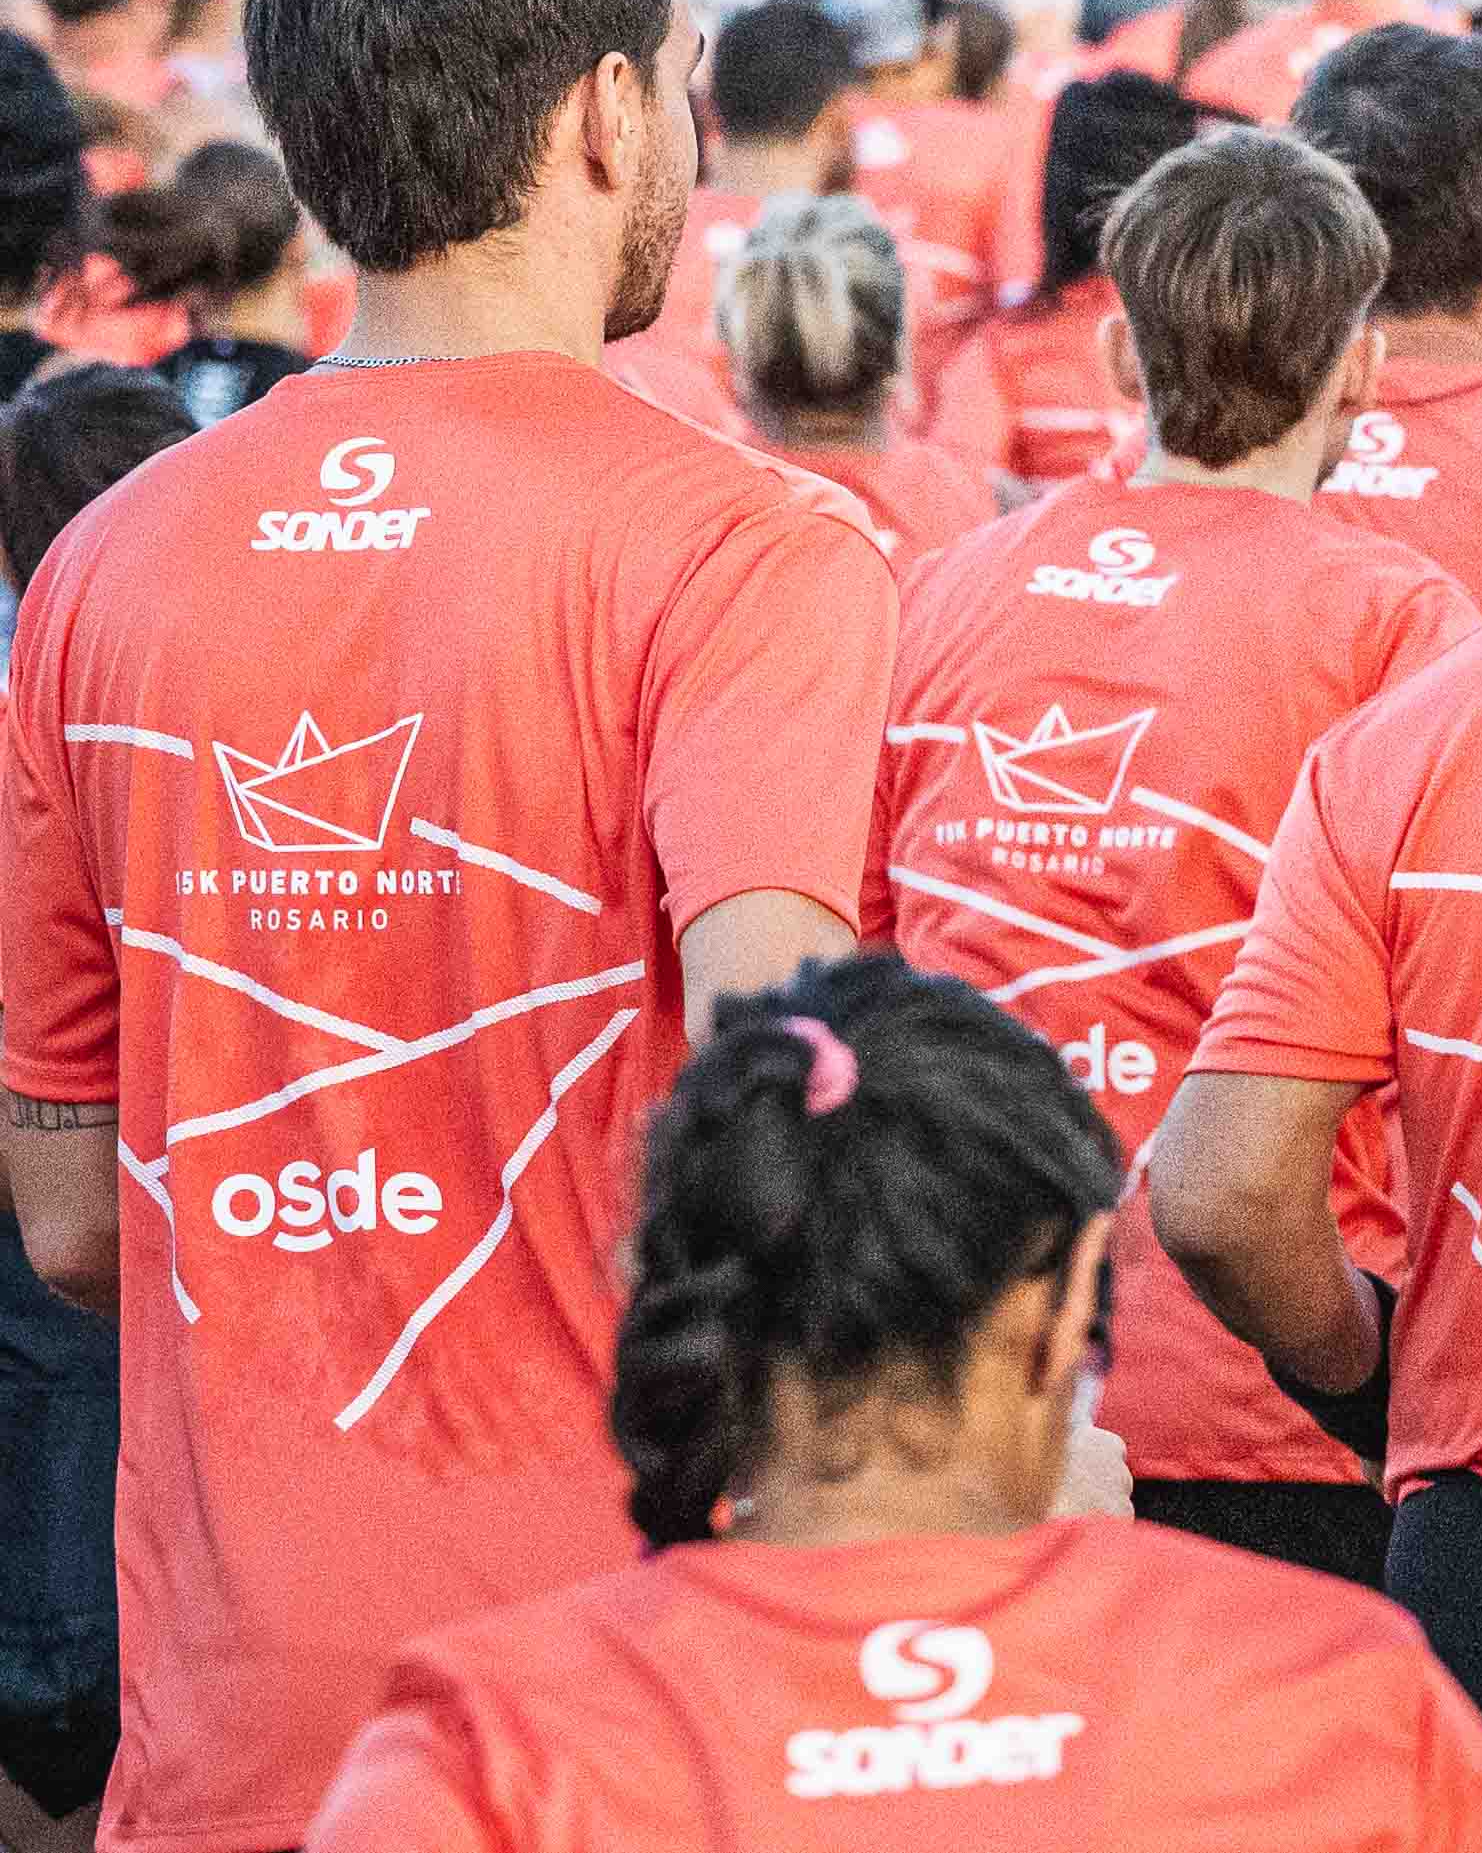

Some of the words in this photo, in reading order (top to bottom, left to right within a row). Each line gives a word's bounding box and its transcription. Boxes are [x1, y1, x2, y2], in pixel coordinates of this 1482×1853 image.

[976, 819, 1088, 848] PUERTO
[992, 847, 1105, 875] ROSARIO
[231, 869, 358, 895] PUERTO
[250, 908, 389, 931] ROSARIO
[211, 1148, 443, 1237] osde
